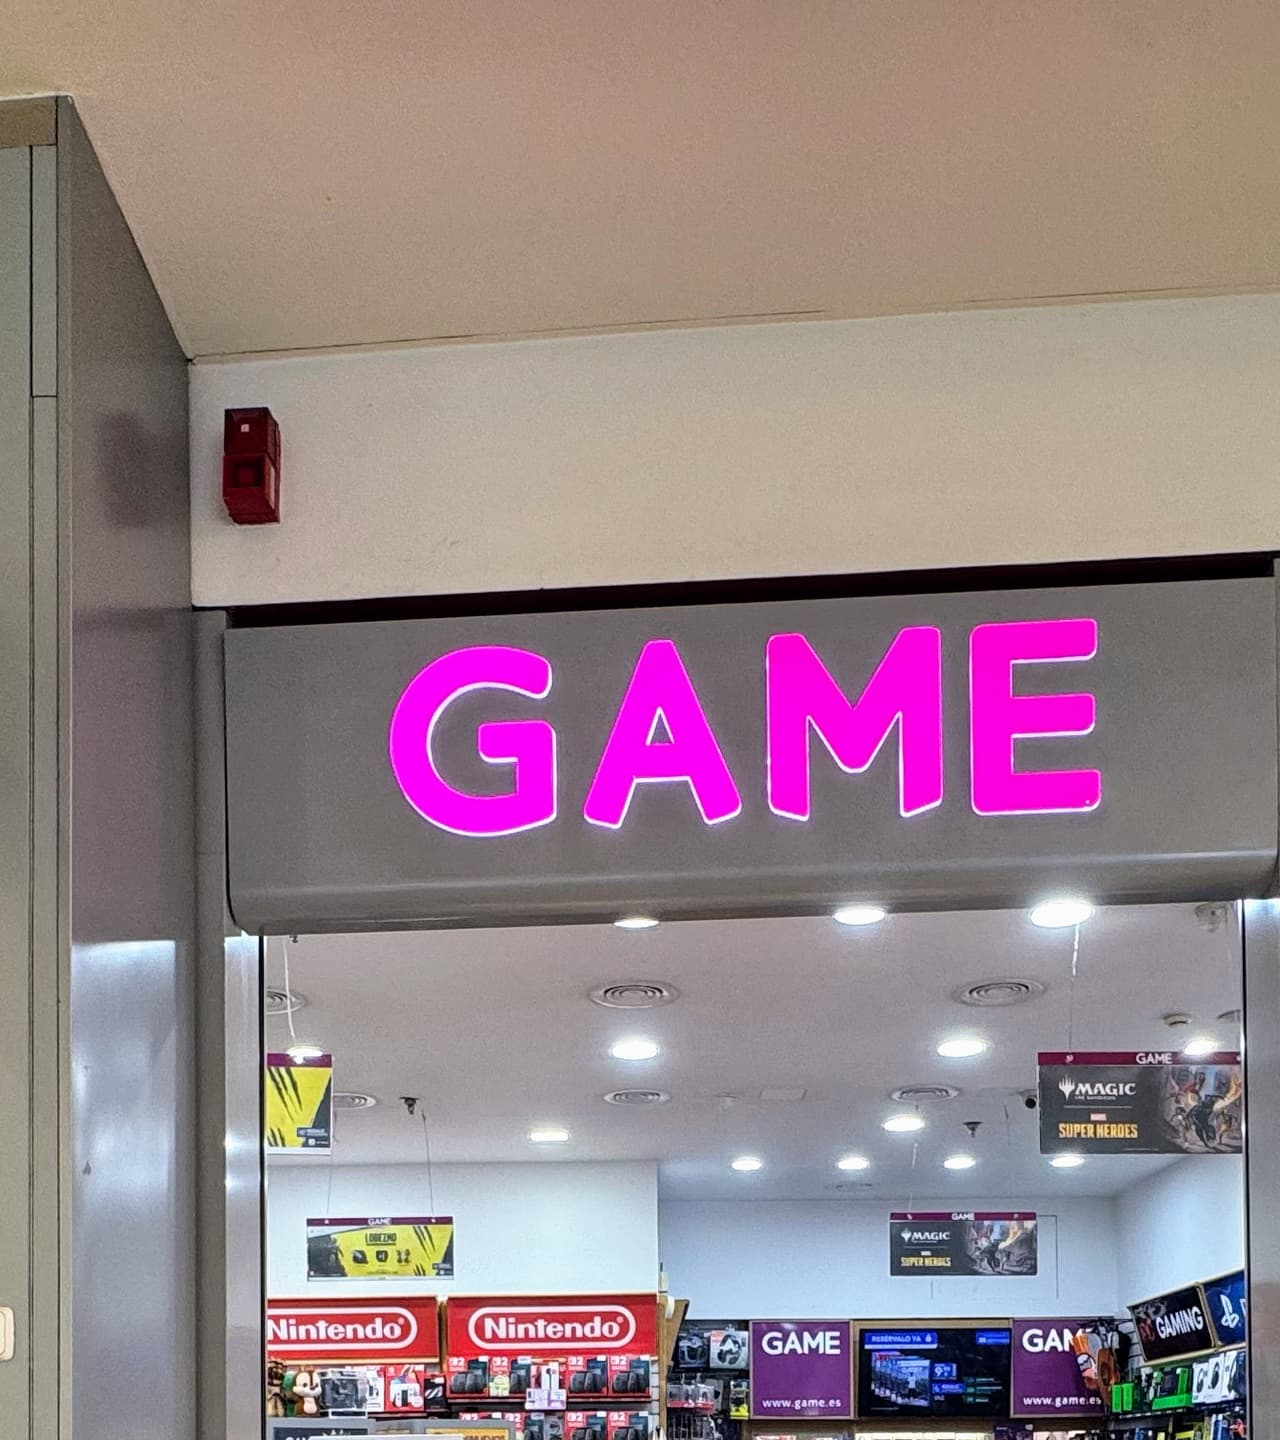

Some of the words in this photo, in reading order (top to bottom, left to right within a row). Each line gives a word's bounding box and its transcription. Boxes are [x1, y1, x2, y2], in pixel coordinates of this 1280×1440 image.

[389, 618, 1102, 838] GAME
[1135, 1052, 1173, 1065] GAME
[1074, 1082, 1136, 1097] MAGIC
[1058, 1124, 1095, 1140] SUPER
[1095, 1122, 1138, 1139] HEROES
[951, 1213, 975, 1221] GAME
[911, 1231, 951, 1242] MAGIC
[267, 1316, 403, 1341] Nintendo
[484, 1315, 621, 1341] Nintendo
[1155, 1305, 1204, 1340] GAMING
[761, 1331, 841, 1356] GAME
[762, 1398, 842, 1410] www.game.es
[1022, 1395, 1102, 1407] www.game.es
